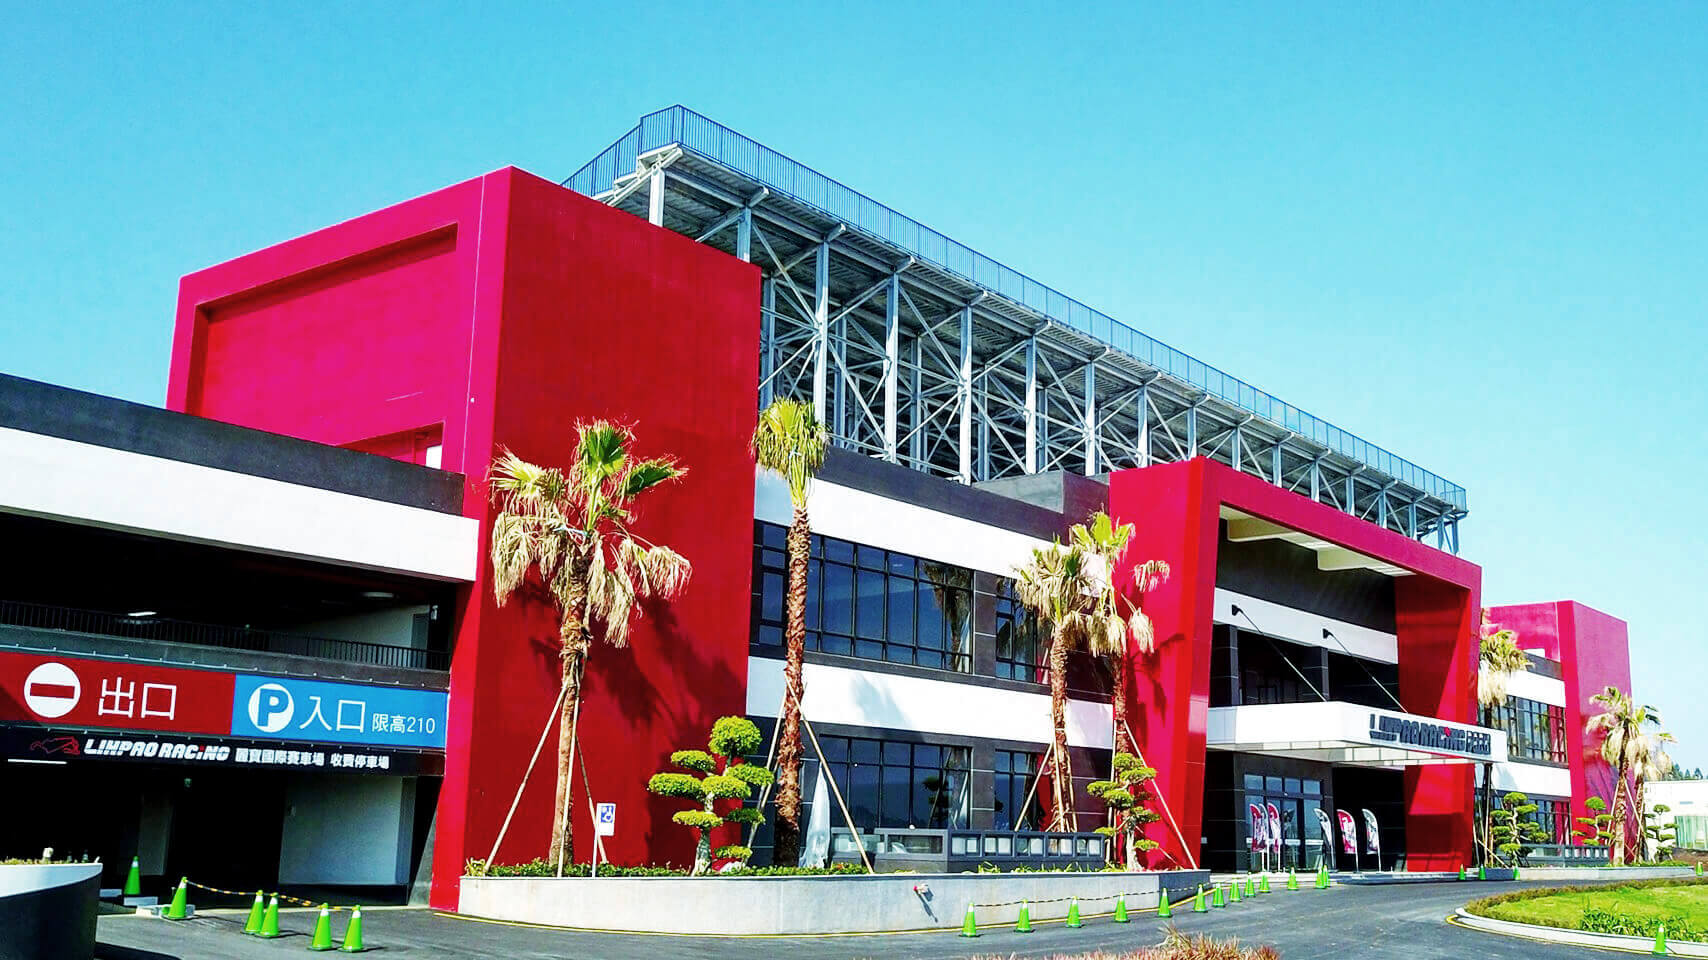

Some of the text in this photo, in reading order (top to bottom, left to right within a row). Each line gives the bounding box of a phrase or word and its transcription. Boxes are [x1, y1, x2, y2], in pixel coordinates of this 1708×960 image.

[98, 677, 176, 720] 出口
[257, 688, 436, 734] P 入口 限高210
[330, 753, 389, 769] 收費停車場
